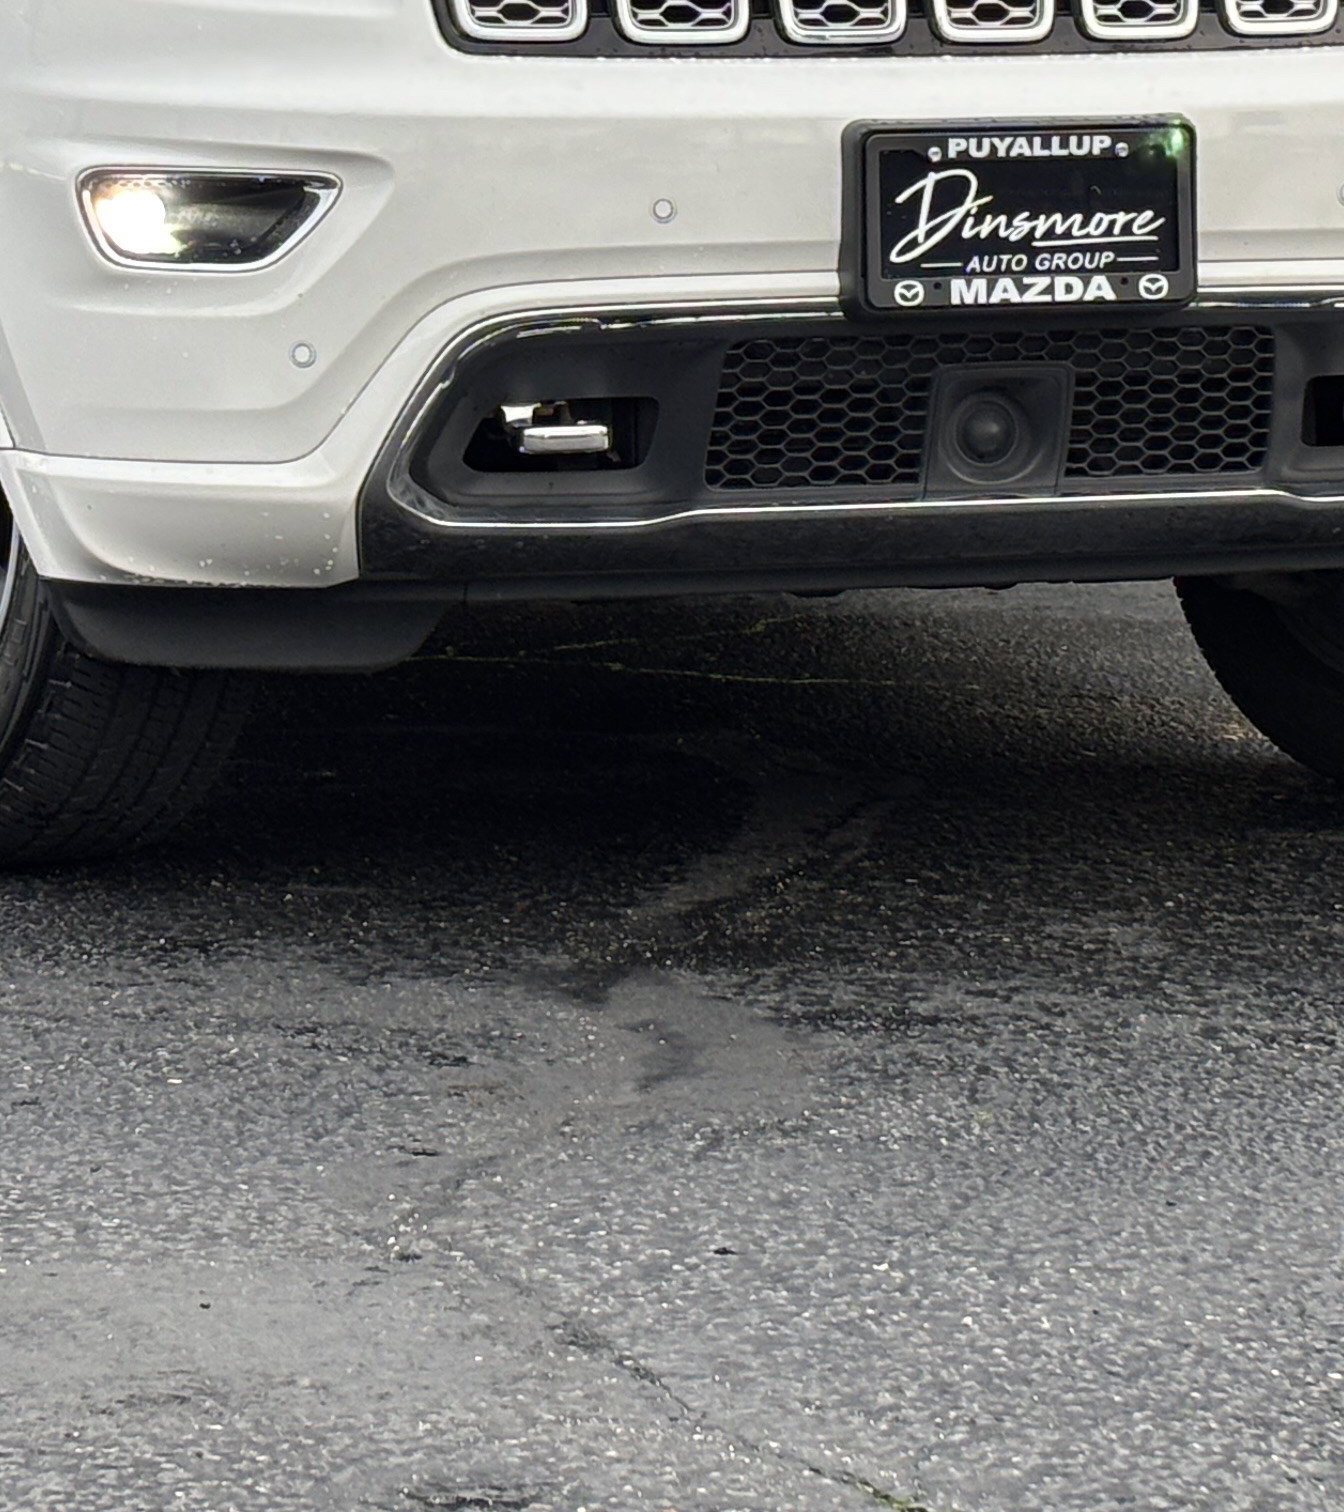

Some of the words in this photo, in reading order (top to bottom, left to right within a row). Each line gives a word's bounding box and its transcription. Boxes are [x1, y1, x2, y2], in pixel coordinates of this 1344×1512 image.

[947, 135, 1112, 159] PUYALLUP
[890, 169, 1165, 263] Dinsmore
[965, 254, 1028, 273] AUTO
[1034, 251, 1116, 271] GROUP
[950, 274, 1117, 305] MAZDA
